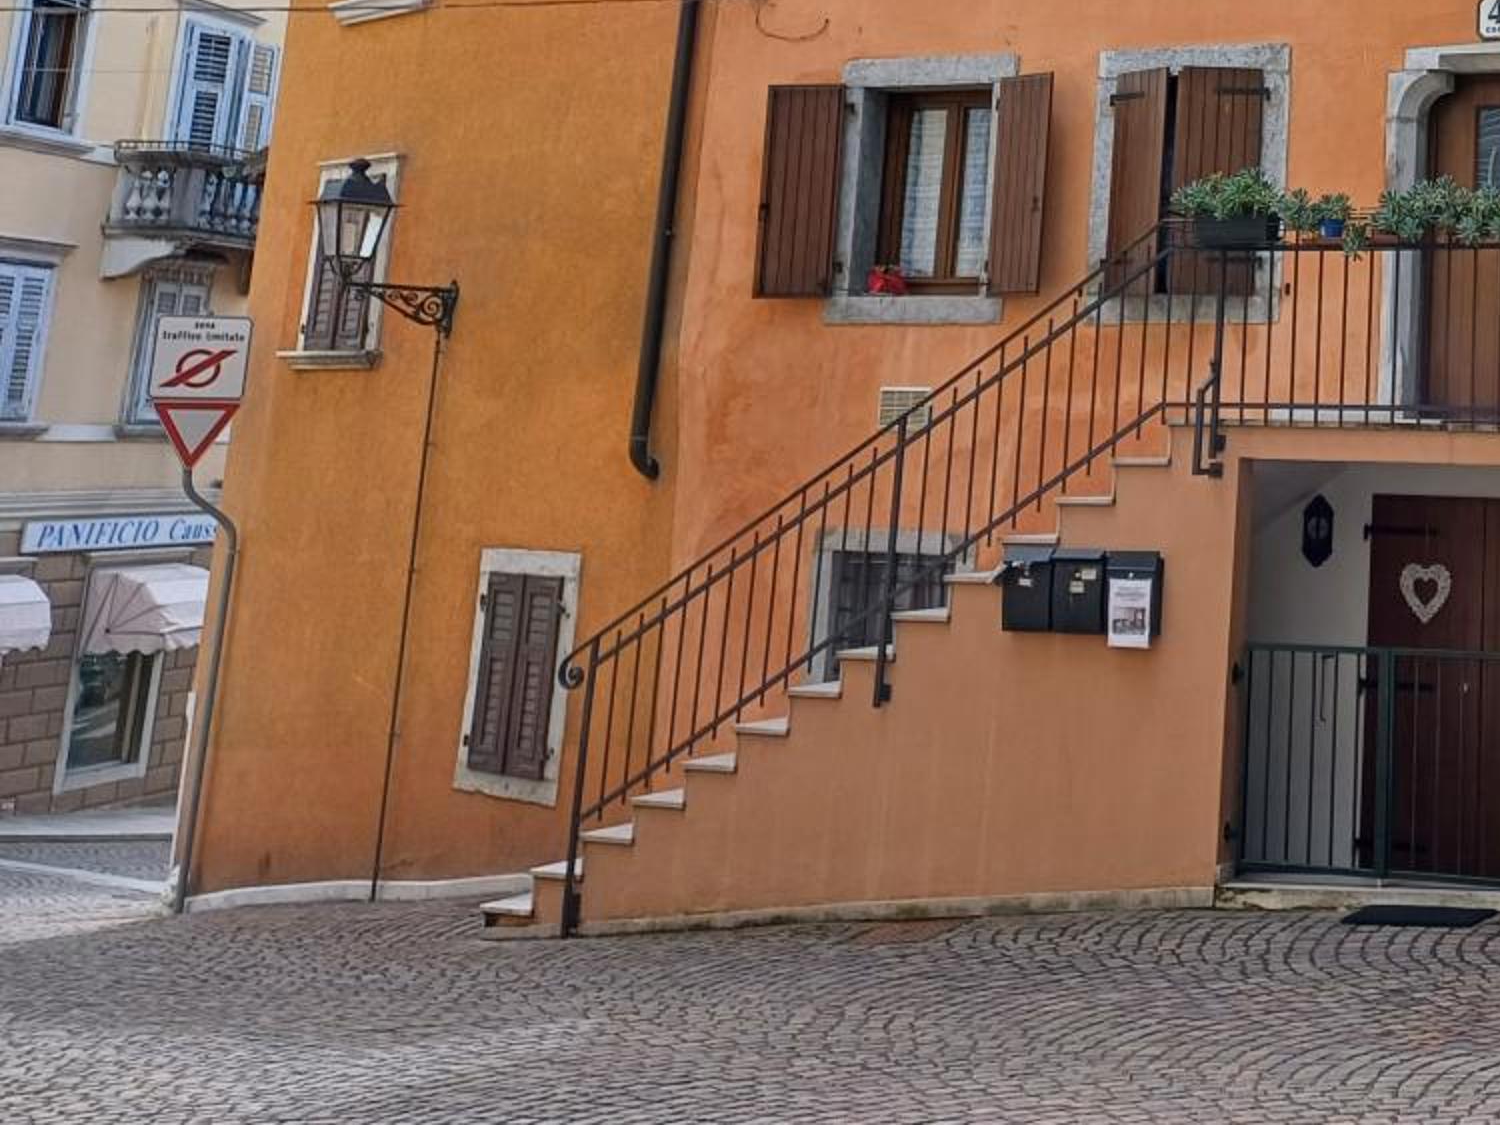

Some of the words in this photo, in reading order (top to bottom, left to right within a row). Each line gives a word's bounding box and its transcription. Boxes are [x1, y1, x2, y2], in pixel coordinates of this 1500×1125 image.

[162, 330, 202, 341] traffico
[206, 331, 246, 342] limitato
[37, 519, 161, 548] PANIFICIO
